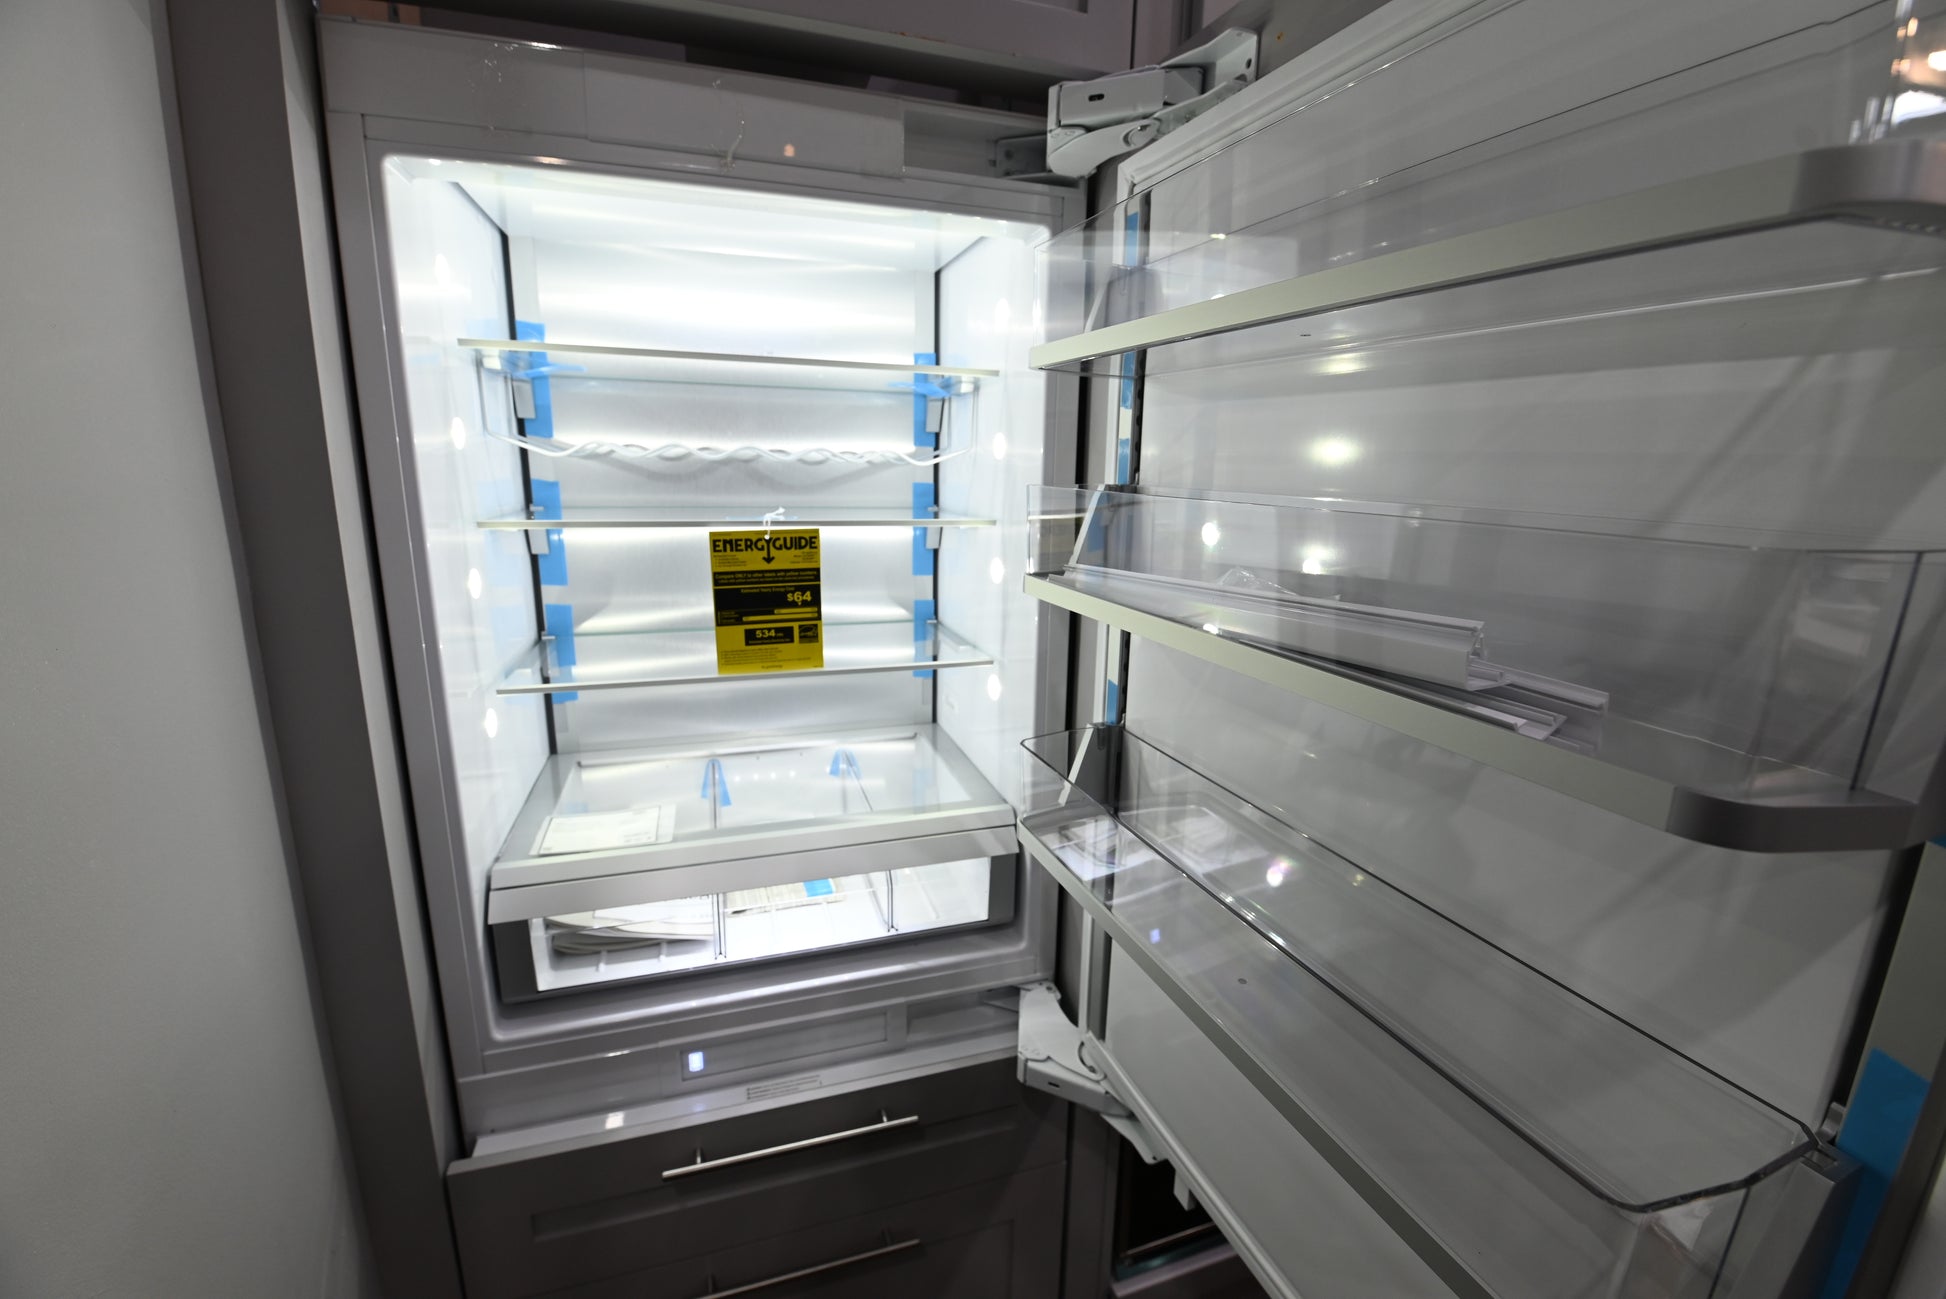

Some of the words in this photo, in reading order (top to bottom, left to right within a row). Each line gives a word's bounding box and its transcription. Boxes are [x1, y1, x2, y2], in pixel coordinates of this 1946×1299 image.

[712, 536, 817, 553] ENERGYGUIDE
[786, 590, 812, 603] $64
[755, 629, 776, 638] 534
